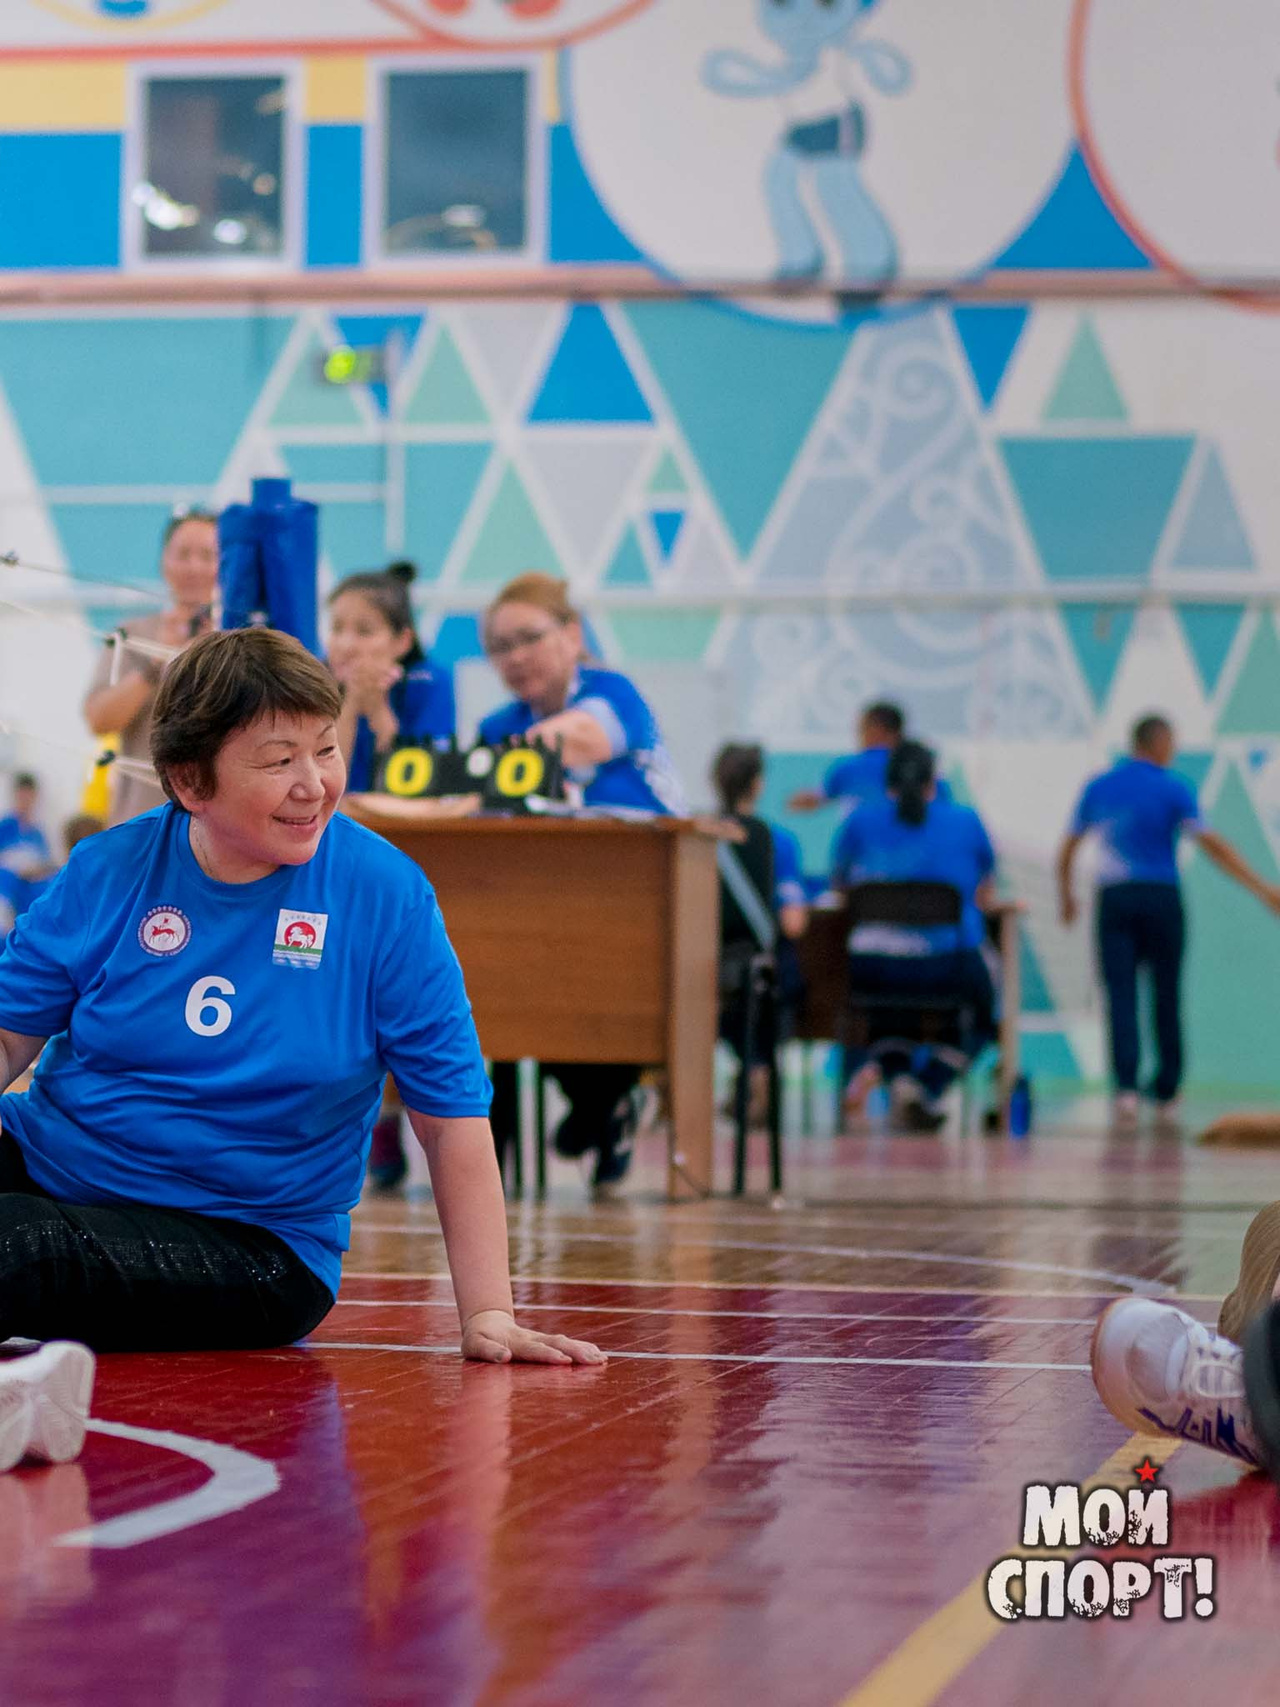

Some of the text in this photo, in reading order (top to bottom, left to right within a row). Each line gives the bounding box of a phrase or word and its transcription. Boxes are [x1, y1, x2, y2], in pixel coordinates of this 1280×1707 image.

[385, 747, 433, 796] 0
[495, 748, 544, 797] 0
[184, 975, 236, 1037] 6
